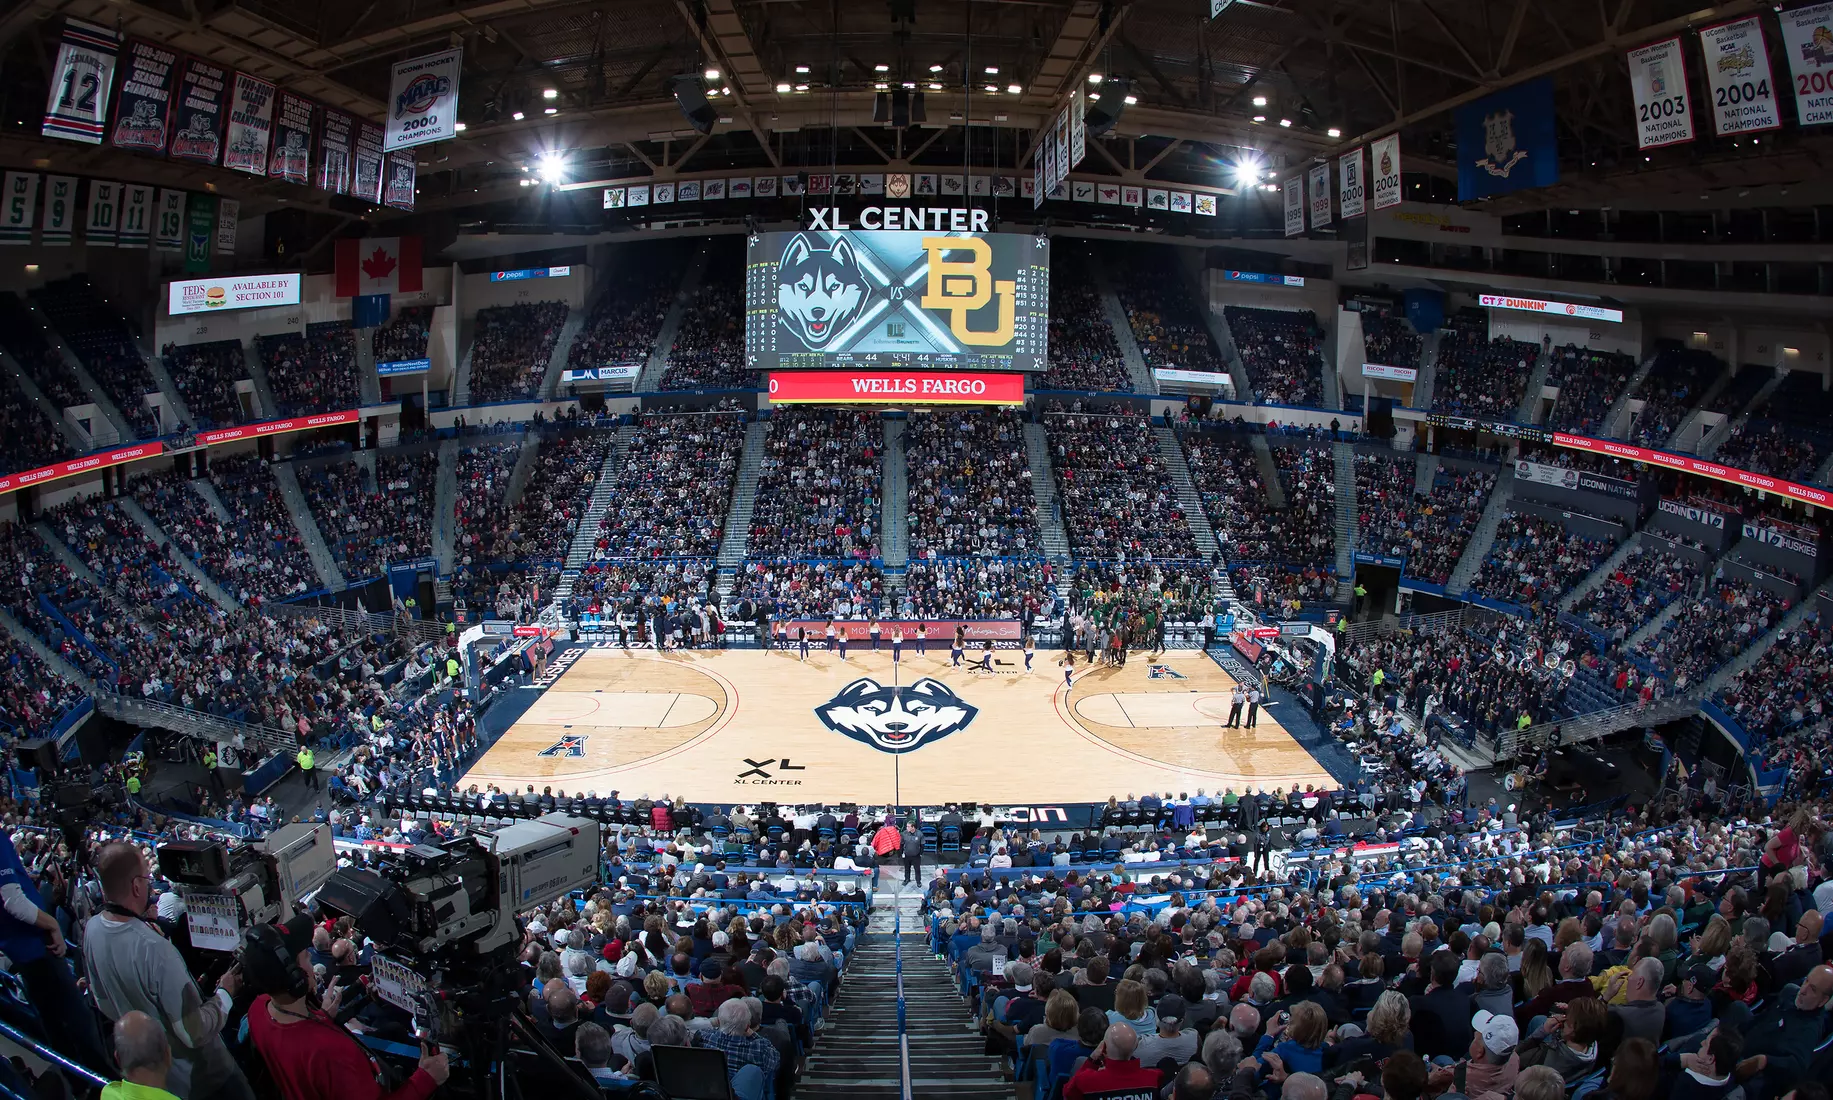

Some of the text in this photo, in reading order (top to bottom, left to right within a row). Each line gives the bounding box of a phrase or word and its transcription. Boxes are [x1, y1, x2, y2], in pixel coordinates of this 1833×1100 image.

[1789, 3, 1832, 18] UConn Men's
[1795, 14, 1830, 27] Basketball
[1705, 20, 1754, 38] UConn Women's
[1716, 31, 1747, 44] Basketball
[1631, 41, 1675, 58] UConn Women's
[1720, 43, 1735, 52] NCAA
[1640, 52, 1668, 65] Basketball
[397, 56, 456, 76] UCONN HOCKEY
[133, 69, 165, 87] SEASON
[1797, 70, 1833, 95] 200
[61, 68, 101, 113] 12
[123, 80, 169, 102] CHAMPIONS
[1716, 79, 1770, 107] 2004
[395, 75, 452, 121] MAAC
[185, 97, 218, 114] CHAMPIONS
[1640, 96, 1684, 122] 2003
[1724, 104, 1767, 118] NATIONAL
[231, 112, 270, 131] CHAMPIONS
[403, 115, 438, 132] 2000
[1645, 118, 1683, 133] NATIONAL
[1722, 117, 1773, 132] CHAMPIONS
[397, 126, 442, 142] CHAMPIONS
[1644, 130, 1687, 145] CHAMPIONS
[1375, 174, 1399, 192] 2002
[1341, 187, 1363, 202] 2000
[1377, 187, 1397, 199] NATIONAL
[1376, 196, 1399, 208] CHAMPIONS
[11, 197, 24, 223] 5
[53, 199, 65, 227] 9
[93, 203, 113, 227] 10
[1286, 208, 1302, 222] 1995
[1343, 205, 1363, 217] CHAMPIONS
[127, 206, 144, 229] 11
[161, 212, 180, 236] 19
[808, 206, 989, 232] XL CENTER
[1036, 238, 1046, 249] XL
[506, 271, 524, 279] pepsi
[1240, 273, 1259, 281] pepsi
[232, 280, 289, 292] AVAILABLE BY
[921, 236, 1015, 346] BU
[236, 290, 285, 302] SECTION 101
[890, 287, 905, 300] VS
[1481, 296, 1548, 311] CT DUNKIN'
[287, 317, 300, 325] 240
[196, 327, 208, 335] 239
[1589, 332, 1601, 341] 222
[893, 353, 910, 361] 4:41
[1033, 358, 1043, 368] XL
[600, 368, 628, 376] MARCUS
[1366, 364, 1385, 373] RICOH
[851, 378, 986, 395] WELLS FARGO
[308, 414, 345, 425] WELLS FARGO
[257, 421, 292, 433] WELLS FARGO
[206, 430, 242, 442] WELLS FARGO
[1555, 435, 1591, 447] WELLS FARGO
[112, 449, 143, 461] WELLS FARGO
[1604, 444, 1639, 456] WELLS FARGO
[67, 458, 100, 471] WELLS FARGO
[1652, 453, 1685, 466] WELLS FARGO
[1693, 463, 1726, 476] WELLS FARGO
[19, 470, 54, 484] WELLS FARGO
[1580, 477, 1607, 491] UCONN
[1739, 474, 1774, 488] WELLS FARGO
[1788, 485, 1826, 502] WELLS FARGO
[1658, 500, 1687, 518] UCONN
[1668, 541, 1677, 549] 121
[1782, 536, 1817, 558] HUSKIES
[1753, 571, 1763, 580] 122
[1000, 627, 1016, 635] Sun
[736, 758, 806, 779] XL
[733, 778, 803, 786] XL CENTER
[582, 864, 593, 875] HD
